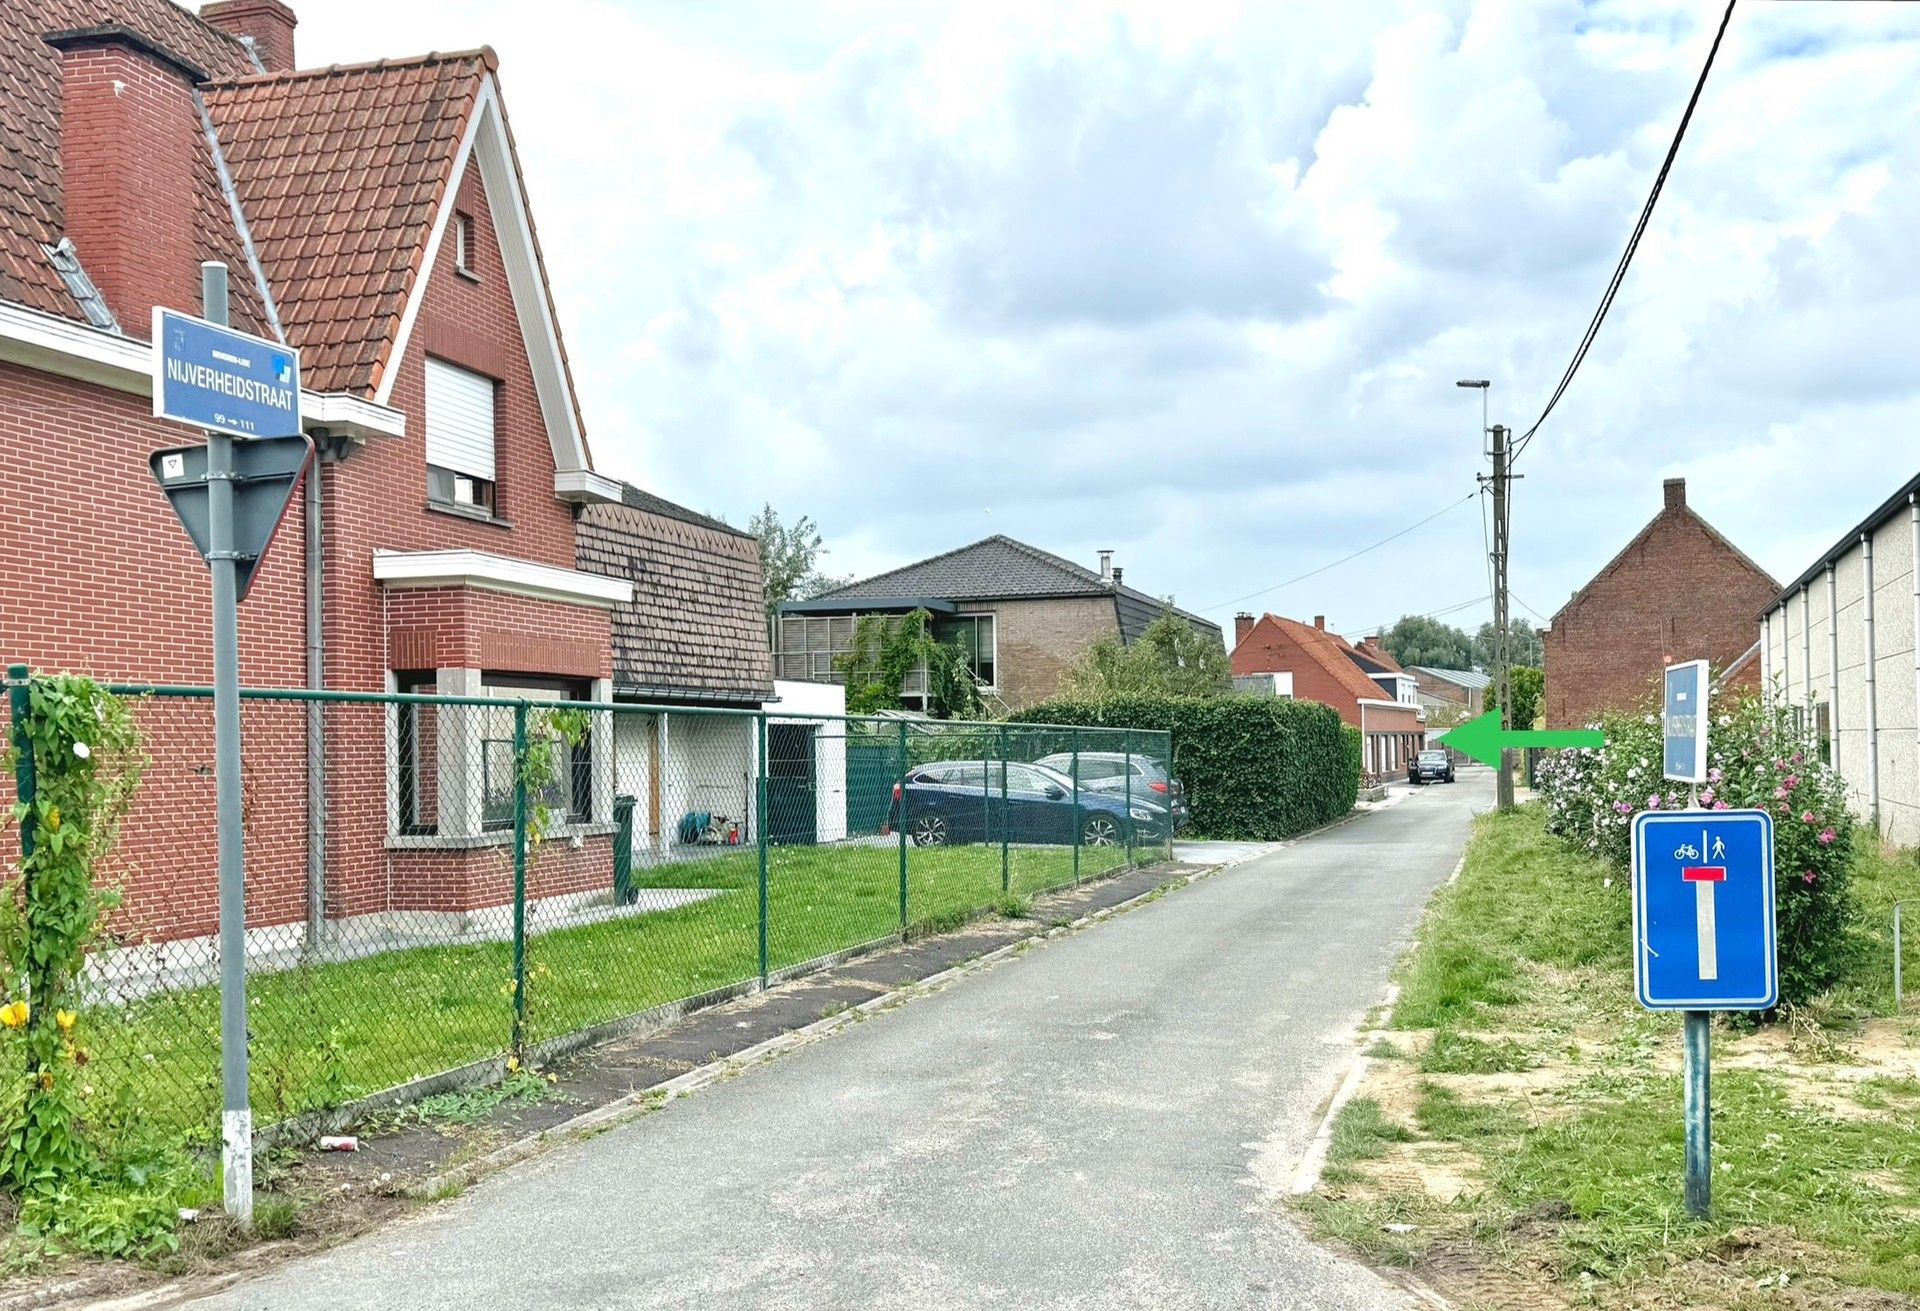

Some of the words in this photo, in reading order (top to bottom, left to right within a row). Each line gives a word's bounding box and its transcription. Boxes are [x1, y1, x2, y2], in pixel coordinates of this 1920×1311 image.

[167, 357, 292, 411] NIJVERHEIDSTRAAT
[214, 413, 226, 424] 99
[240, 419, 254, 431] 111
